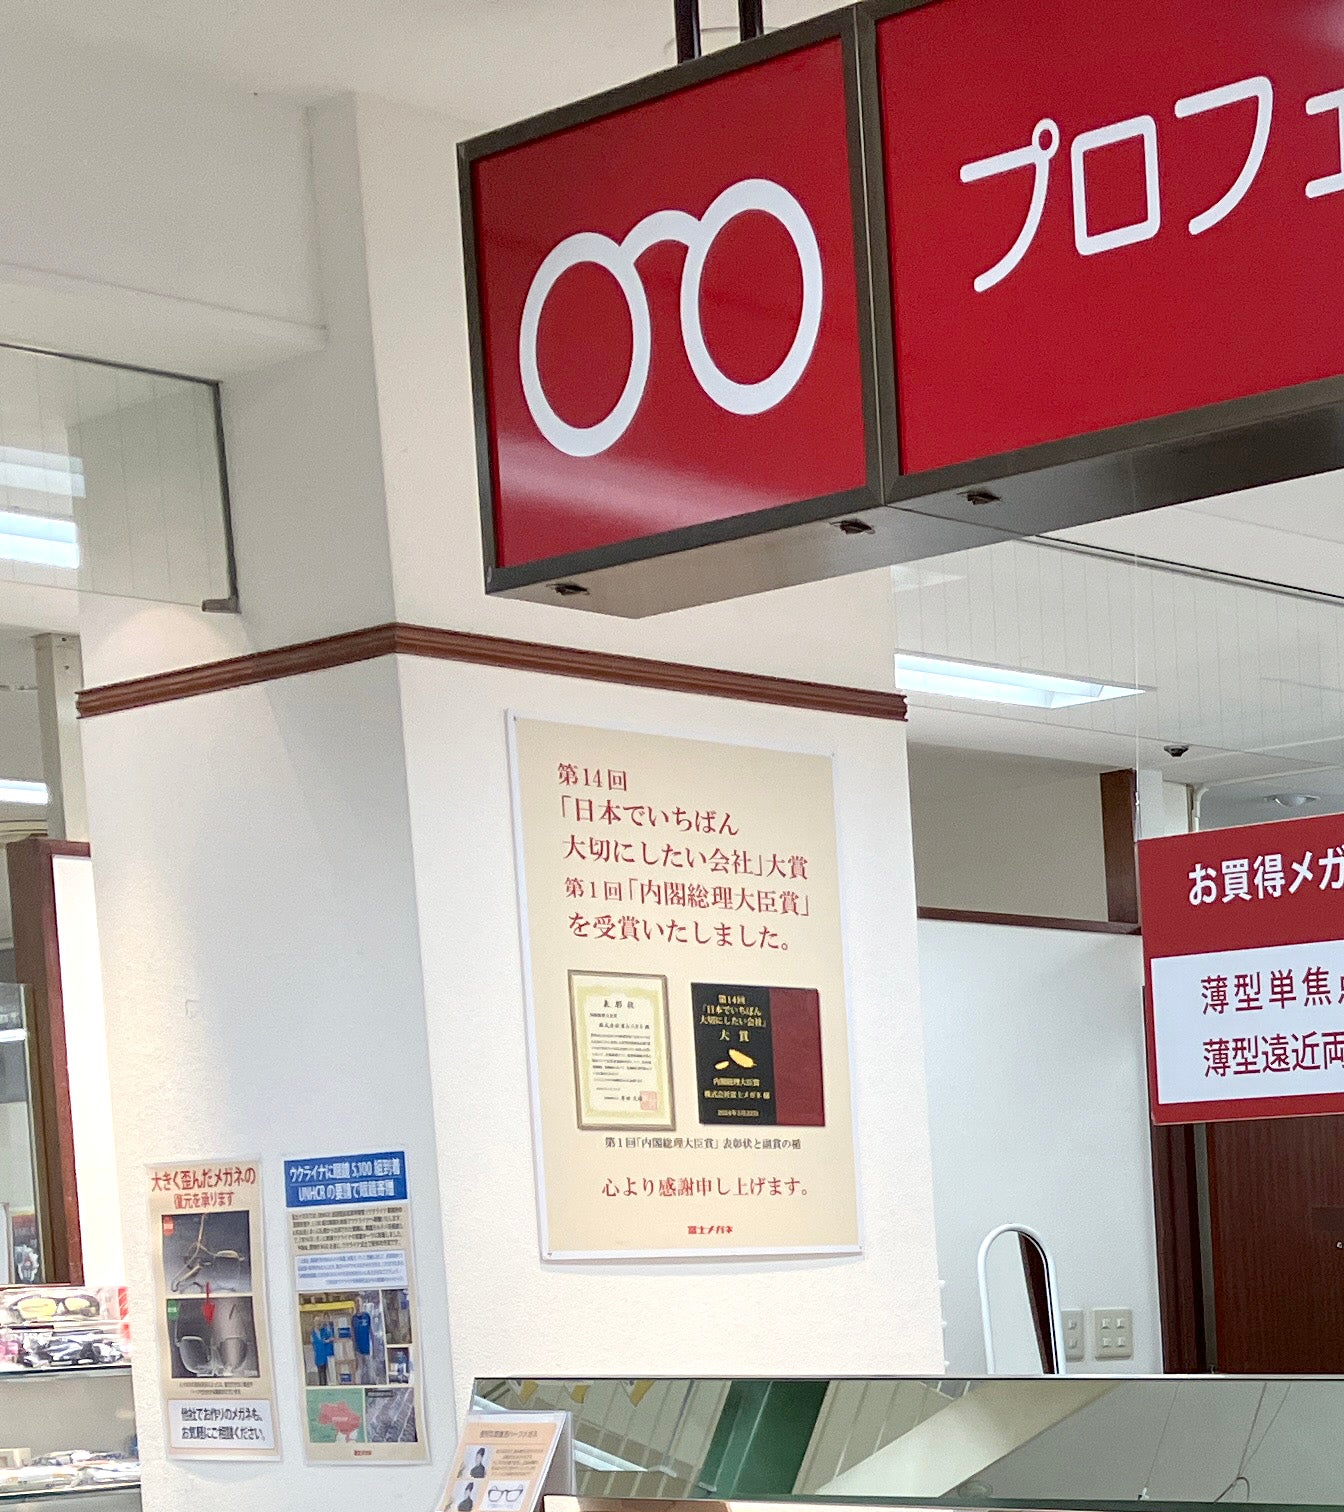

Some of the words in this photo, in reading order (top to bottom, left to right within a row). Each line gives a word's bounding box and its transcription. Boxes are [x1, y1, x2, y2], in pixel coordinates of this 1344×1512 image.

[557, 762, 628, 792] 第14回
[561, 796, 739, 837] 「日本でいちばん
[563, 835, 808, 881] 大切にしたい会社」大賞
[565, 876, 810, 917] 第1回「内閣総理大臣賞」
[568, 913, 790, 952] を受賞いたしました。
[151, 1167, 256, 1192] 大きく歪んだメガネの
[601, 1176, 809, 1198] 心より感謝申し上げます。
[174, 1192, 235, 1209] 復元を承ります
